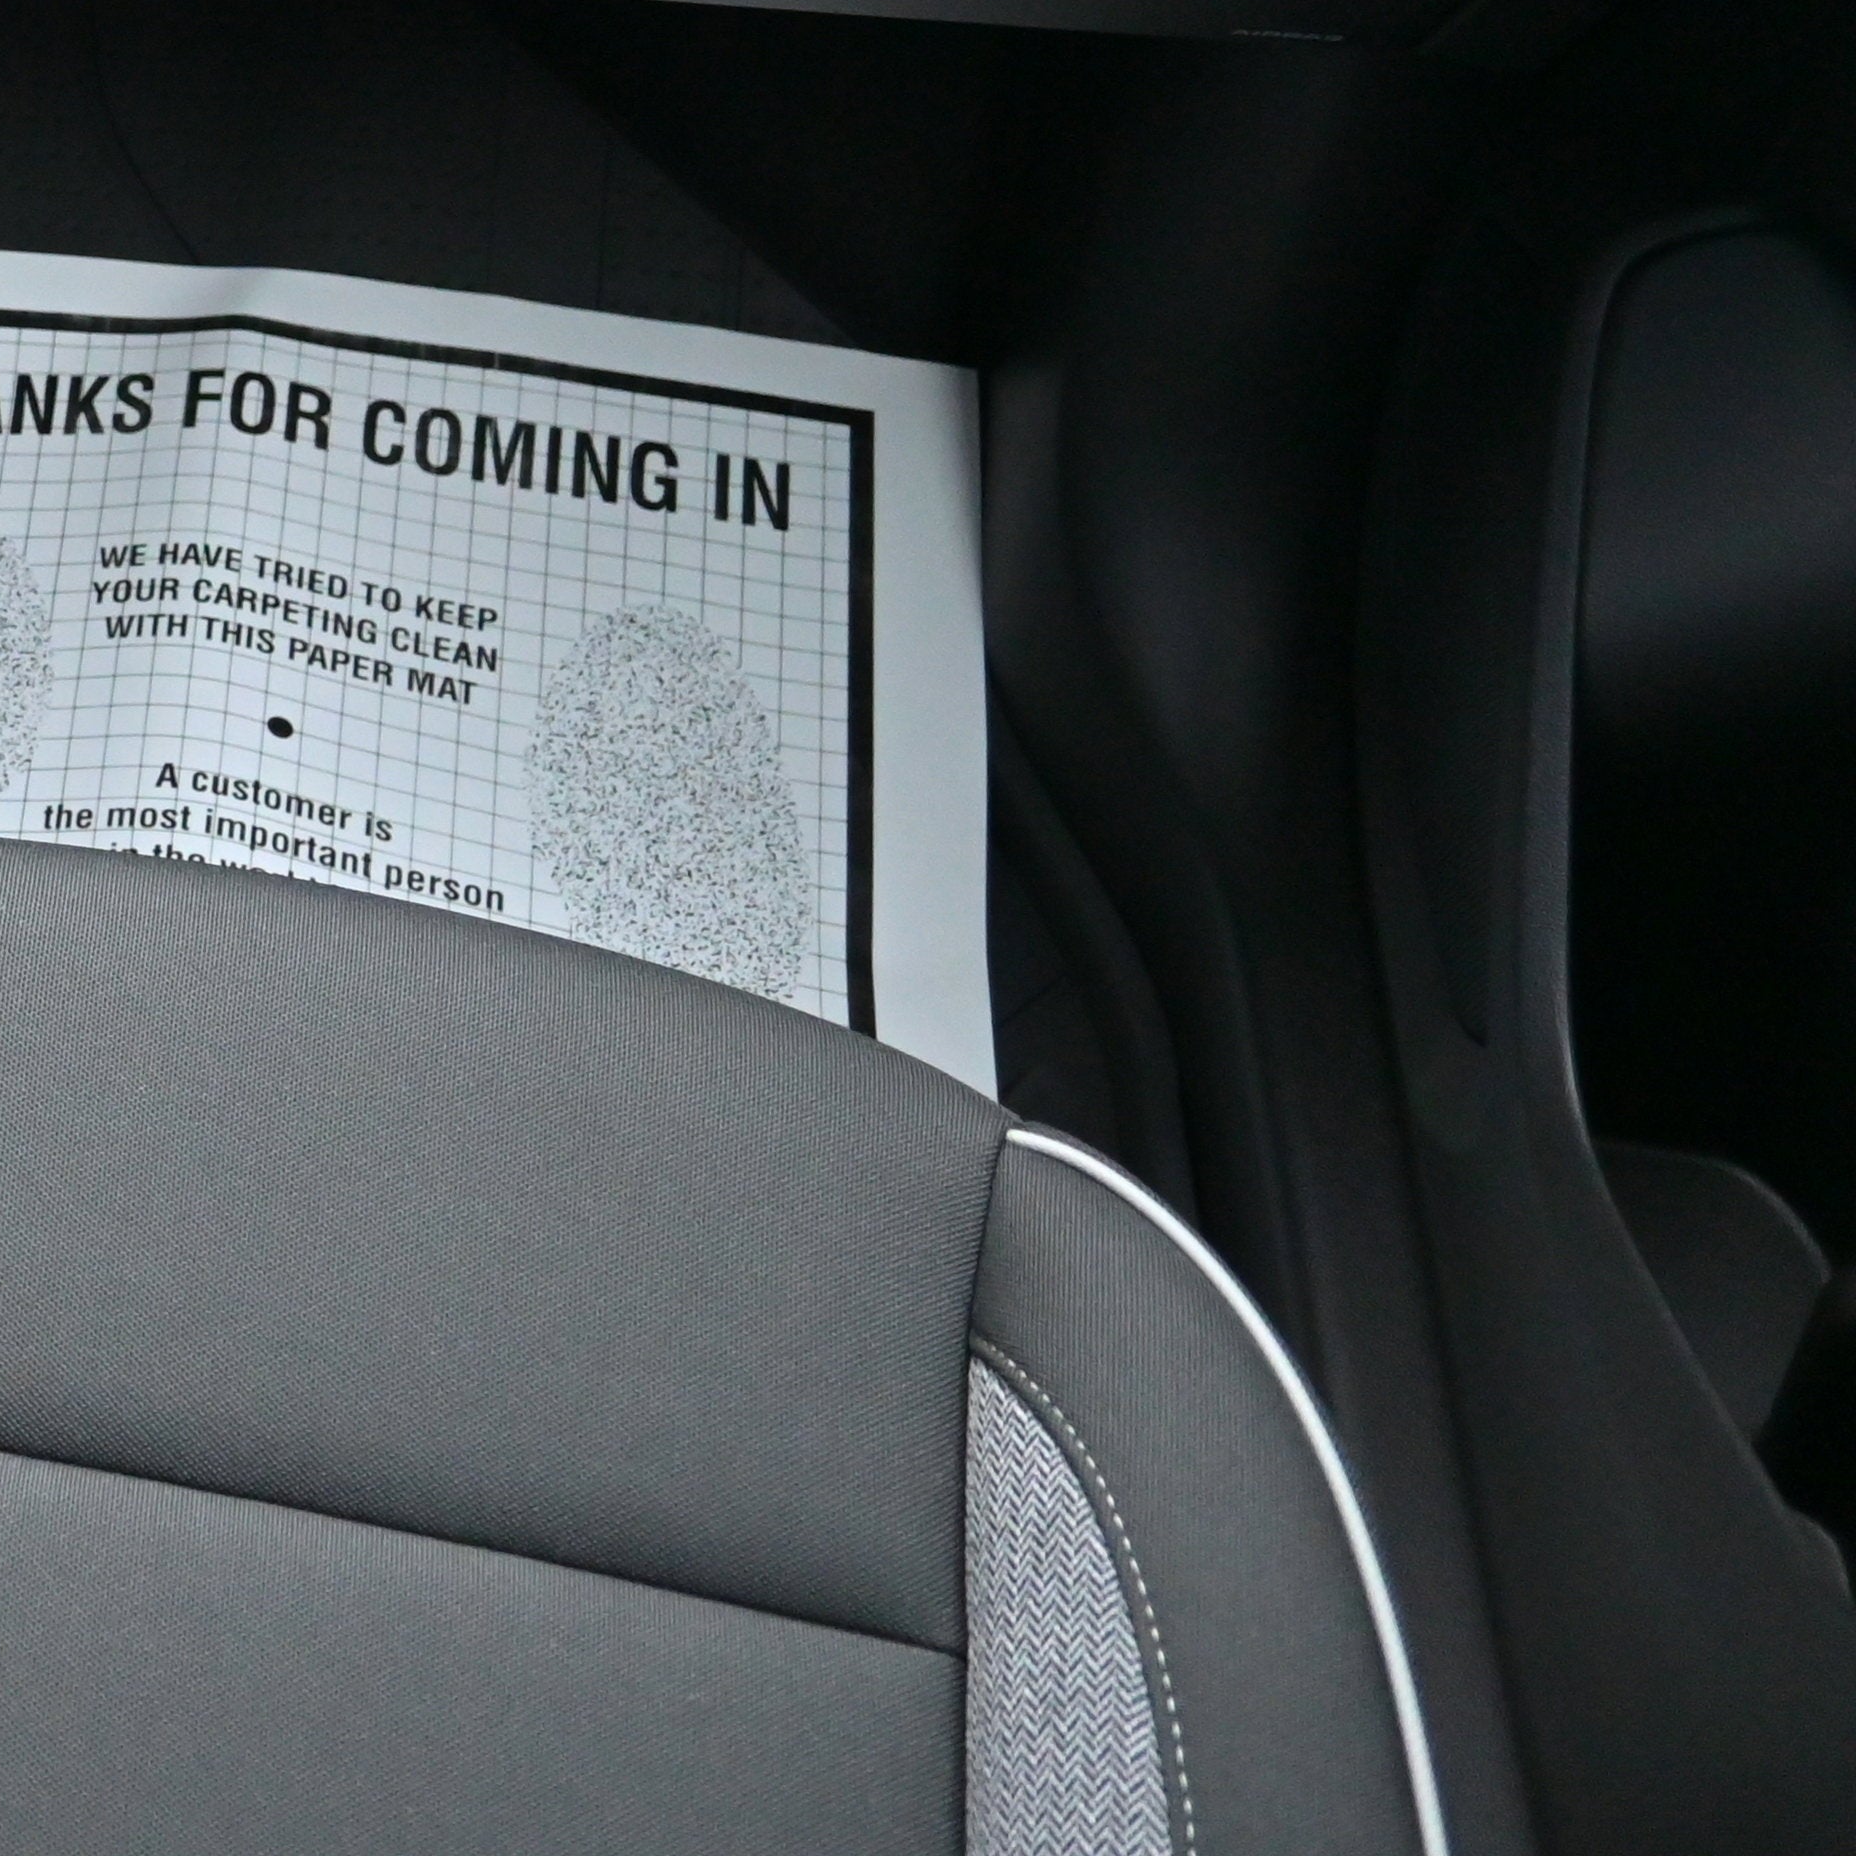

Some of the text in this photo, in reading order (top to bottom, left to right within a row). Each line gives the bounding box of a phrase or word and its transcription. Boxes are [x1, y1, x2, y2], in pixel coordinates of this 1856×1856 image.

[183, 368, 333, 450] FOR
[362, 399, 680, 516] COMING
[713, 452, 793, 532] IN
[93, 578, 498, 673] YOUR CARPETING CLEAN
[100, 543, 498, 633] WE HAVE TRIED TO KEEP
[106, 614, 478, 705] WITH THIS PAPER MAT
[155, 762, 393, 842] A customer is
[43, 804, 93, 830] the
[107, 804, 191, 832] most
[205, 808, 374, 878] important
[384, 862, 505, 912] person
